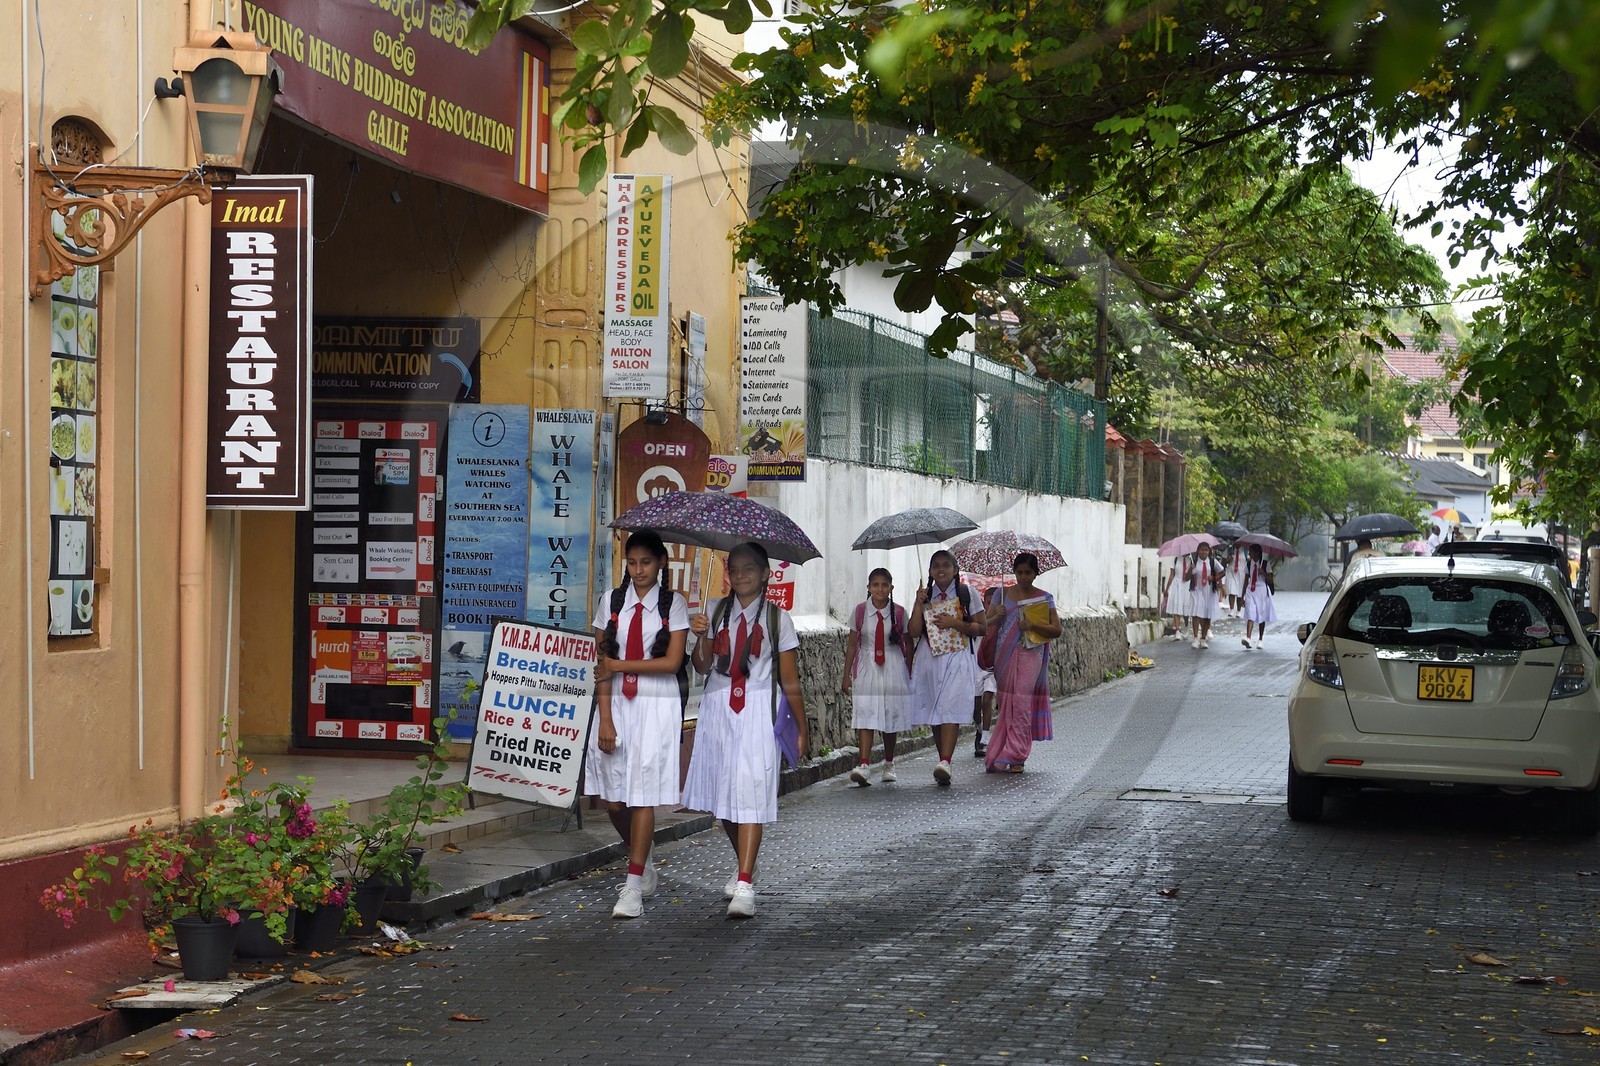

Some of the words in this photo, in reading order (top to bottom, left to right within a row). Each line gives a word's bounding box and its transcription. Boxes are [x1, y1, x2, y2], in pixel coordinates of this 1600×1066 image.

[244, 0, 304, 63] YOUNG
[309, 34, 351, 86] MENS
[354, 58, 426, 122] BUDDHIST
[427, 95, 515, 156] ASSOCIATION
[367, 109, 409, 156] GALLE
[221, 198, 286, 224] Imal
[637, 184, 654, 288] AYURVEDA
[615, 183, 631, 313] HAIRDRESSERS
[633, 293, 654, 310] OIL
[748, 301, 768, 311] Photo
[611, 319, 653, 327] MASSAGE
[748, 315, 761, 324] Fax
[634, 329, 653, 337] FACE
[748, 328, 788, 340] Laminating
[620, 338, 642, 346] BODY
[748, 341, 762, 350] IDD
[764, 341, 781, 350] Calls
[610, 347, 652, 357] MILTON
[221, 231, 281, 489] RESTAURANT
[748, 354, 767, 363] Local
[768, 353, 785, 363] Calls
[312, 351, 432, 376] OMMUNICATION
[612, 359, 649, 370] SALON
[748, 367, 776, 376] Internet
[371, 380, 387, 388] FAX
[389, 381, 417, 389] PHOTO
[418, 382, 440, 390] COPY
[748, 380, 789, 390] Stationaries
[748, 393, 760, 402] Sim
[763, 393, 782, 402] Cards
[748, 406, 780, 417] Recharge
[782, 405, 802, 415] Cards
[536, 411, 593, 424] WHALESLANKA
[748, 419, 752, 428] &
[755, 419, 782, 429] Reloads
[319, 429, 341, 438] Dialog
[361, 429, 382, 438] Dialog
[404, 430, 425, 439] Dialog
[317, 443, 332, 451] Photo
[333, 443, 349, 452] Copy
[644, 443, 687, 456] OPEN
[456, 457, 520, 467] WHALESLANKA
[708, 459, 737, 474] alog
[470, 469, 506, 478] WHALES
[748, 465, 802, 476] OMMUNICATION
[317, 477, 351, 485] Laminating
[550, 435, 575, 518] WHALE
[706, 472, 731, 487] DD
[465, 480, 511, 489] WATCHING
[454, 503, 501, 511] SOUTHERN
[503, 504, 521, 512] SEA
[387, 547, 414, 555] Watching
[452, 551, 494, 561] TRANSPORT
[338, 557, 354, 565] Card
[451, 566, 492, 576] BREAKFAST
[451, 582, 477, 591] SAFETY
[478, 583, 523, 593] EQUIPMENTS
[766, 587, 787, 597] test
[450, 597, 472, 607] FULLY
[472, 599, 517, 609] INSURANCED
[321, 614, 341, 623] Dialog
[364, 615, 384, 624] Dialog
[448, 613, 482, 625] BOOK
[501, 626, 540, 653] Y.M.B.A
[544, 634, 597, 662] CANTEEN
[496, 651, 586, 682] Breakfast
[1435, 668, 1457, 683] KV
[491, 670, 519, 686] Hoppers
[520, 676, 537, 688] Pittu
[539, 679, 561, 693] Thosai
[562, 683, 587, 698] Halape
[1425, 683, 1466, 699] 9094
[493, 690, 576, 721] LUNCH
[484, 709, 515, 727] Rice
[522, 717, 532, 730] &
[541, 720, 580, 742] Curry
[318, 729, 339, 737] Dialog
[362, 730, 382, 738] Dialog
[400, 732, 421, 740] Dialog
[485, 729, 529, 752] Fried
[533, 738, 572, 761] Rice
[489, 750, 563, 775] DINNER
